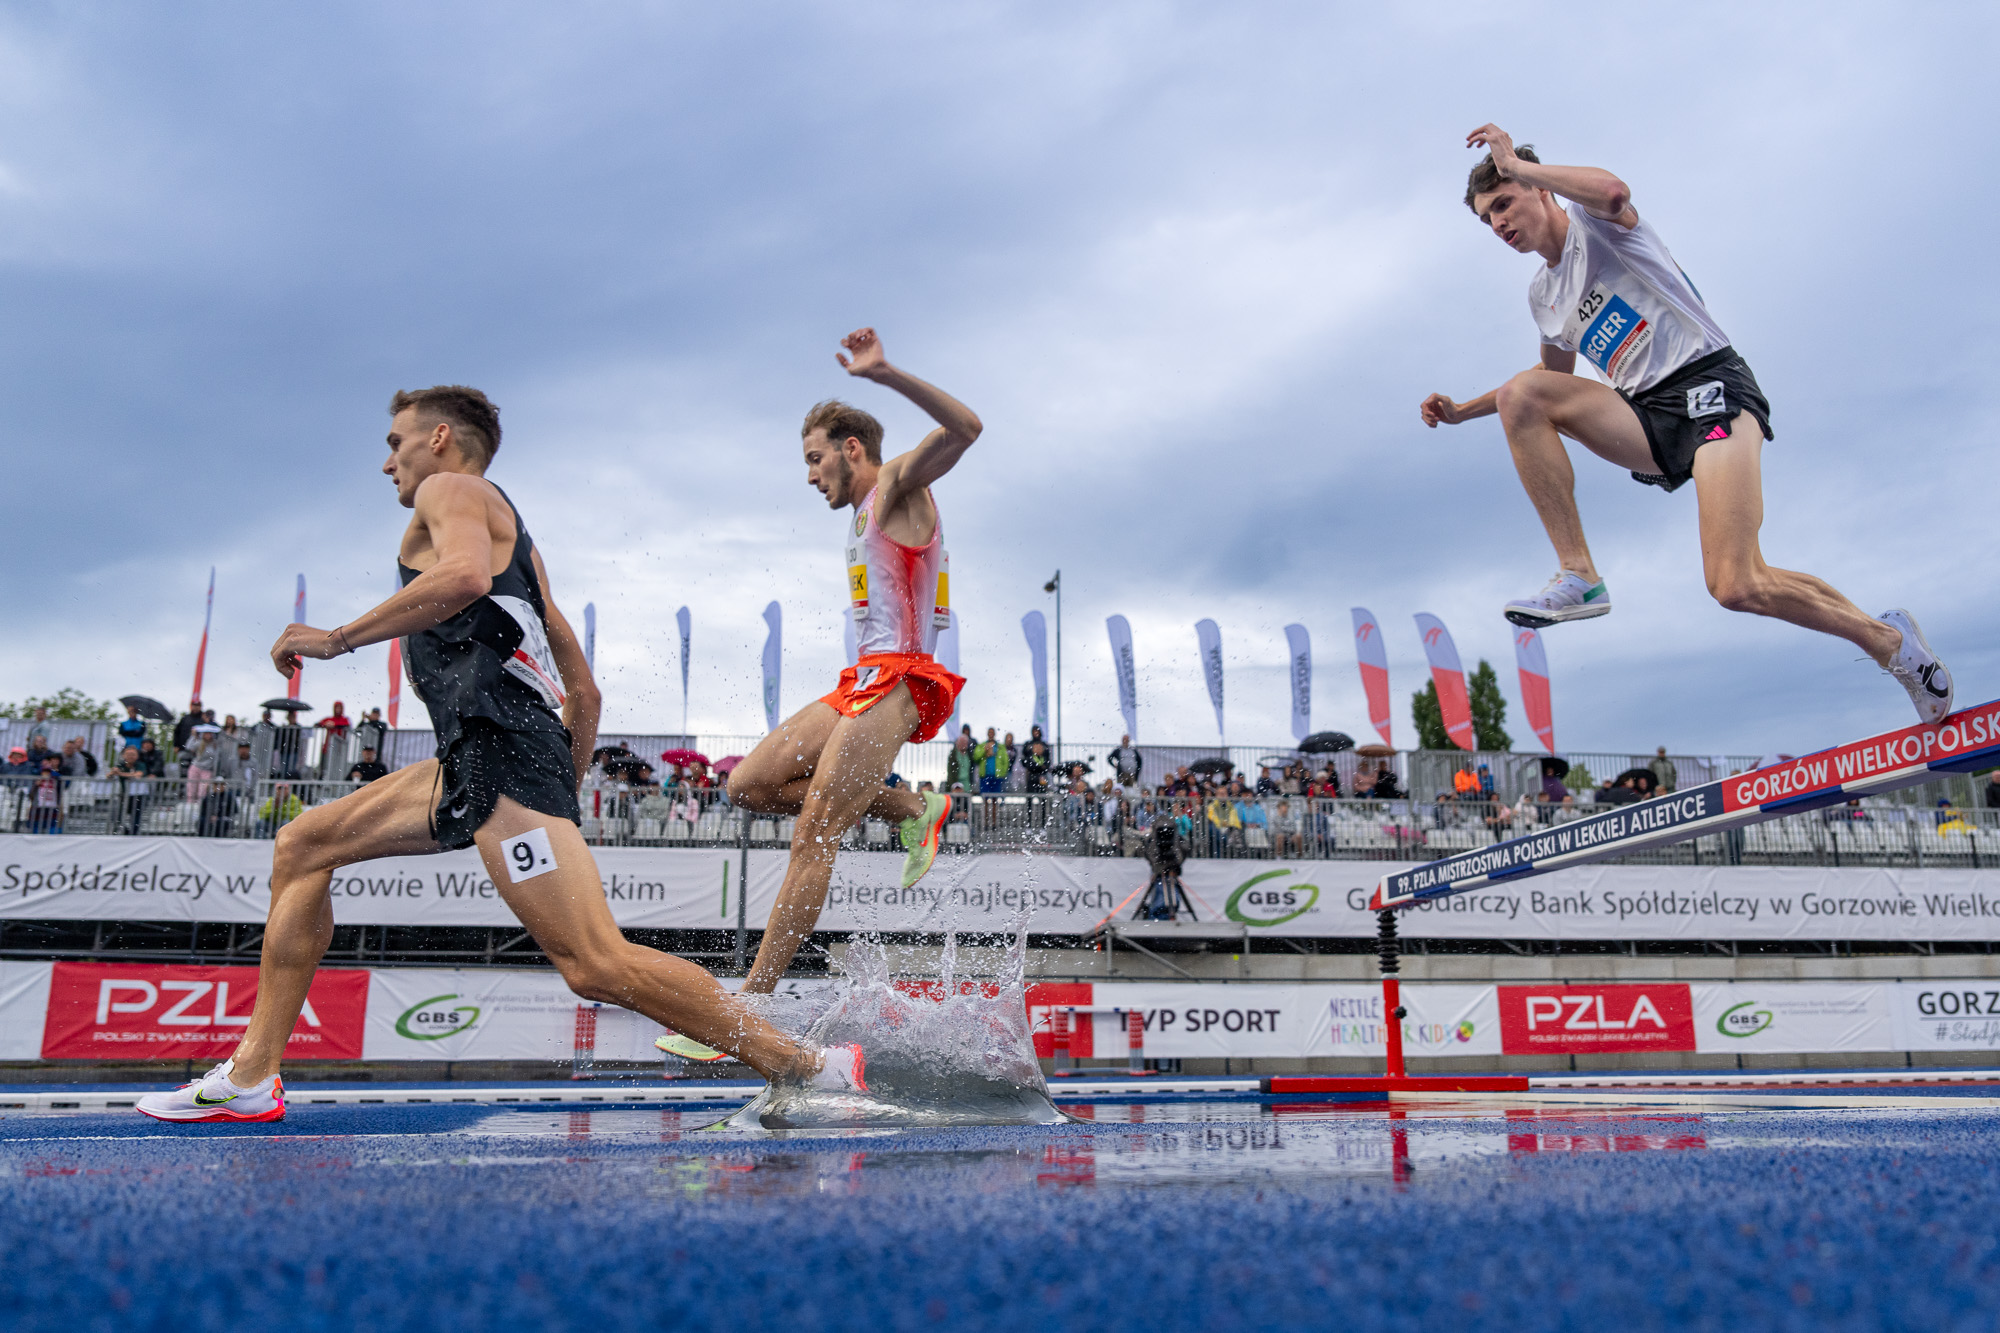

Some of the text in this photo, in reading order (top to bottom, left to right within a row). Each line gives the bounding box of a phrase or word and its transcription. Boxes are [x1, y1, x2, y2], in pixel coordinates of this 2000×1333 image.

[1577, 289, 1604, 323] 425
[1397, 710, 2000, 894] 99. PZLA MISTRZOSTWA POLSKI W LEKKIEJ ATLETYCE GORZÓW WIELKOPOLSK
[512, 841, 548, 872] 9.
[3, 863, 212, 900] Spółdzielczy
[226, 874, 257, 894] w
[827, 883, 1113, 912] pieramy najlepszych
[1247, 891, 1297, 906] GBS
[1531, 889, 1593, 914] Bank
[1603, 889, 1759, 921] Spółdzielczy
[1769, 897, 1793, 915] w
[1801, 892, 1917, 917] Gorzowie
[1330, 996, 1379, 1018] NESTLÉ
[1525, 994, 1667, 1031] PZLA
[1917, 990, 2000, 1015] GORZ
[416, 1011, 461, 1024] GBS
[1185, 1008, 1281, 1033] SPORT
[1729, 1014, 1760, 1026] GBS
[93, 1031, 143, 1043] POLSKI
[1331, 1022, 1454, 1044] HEALTHR KIDS
